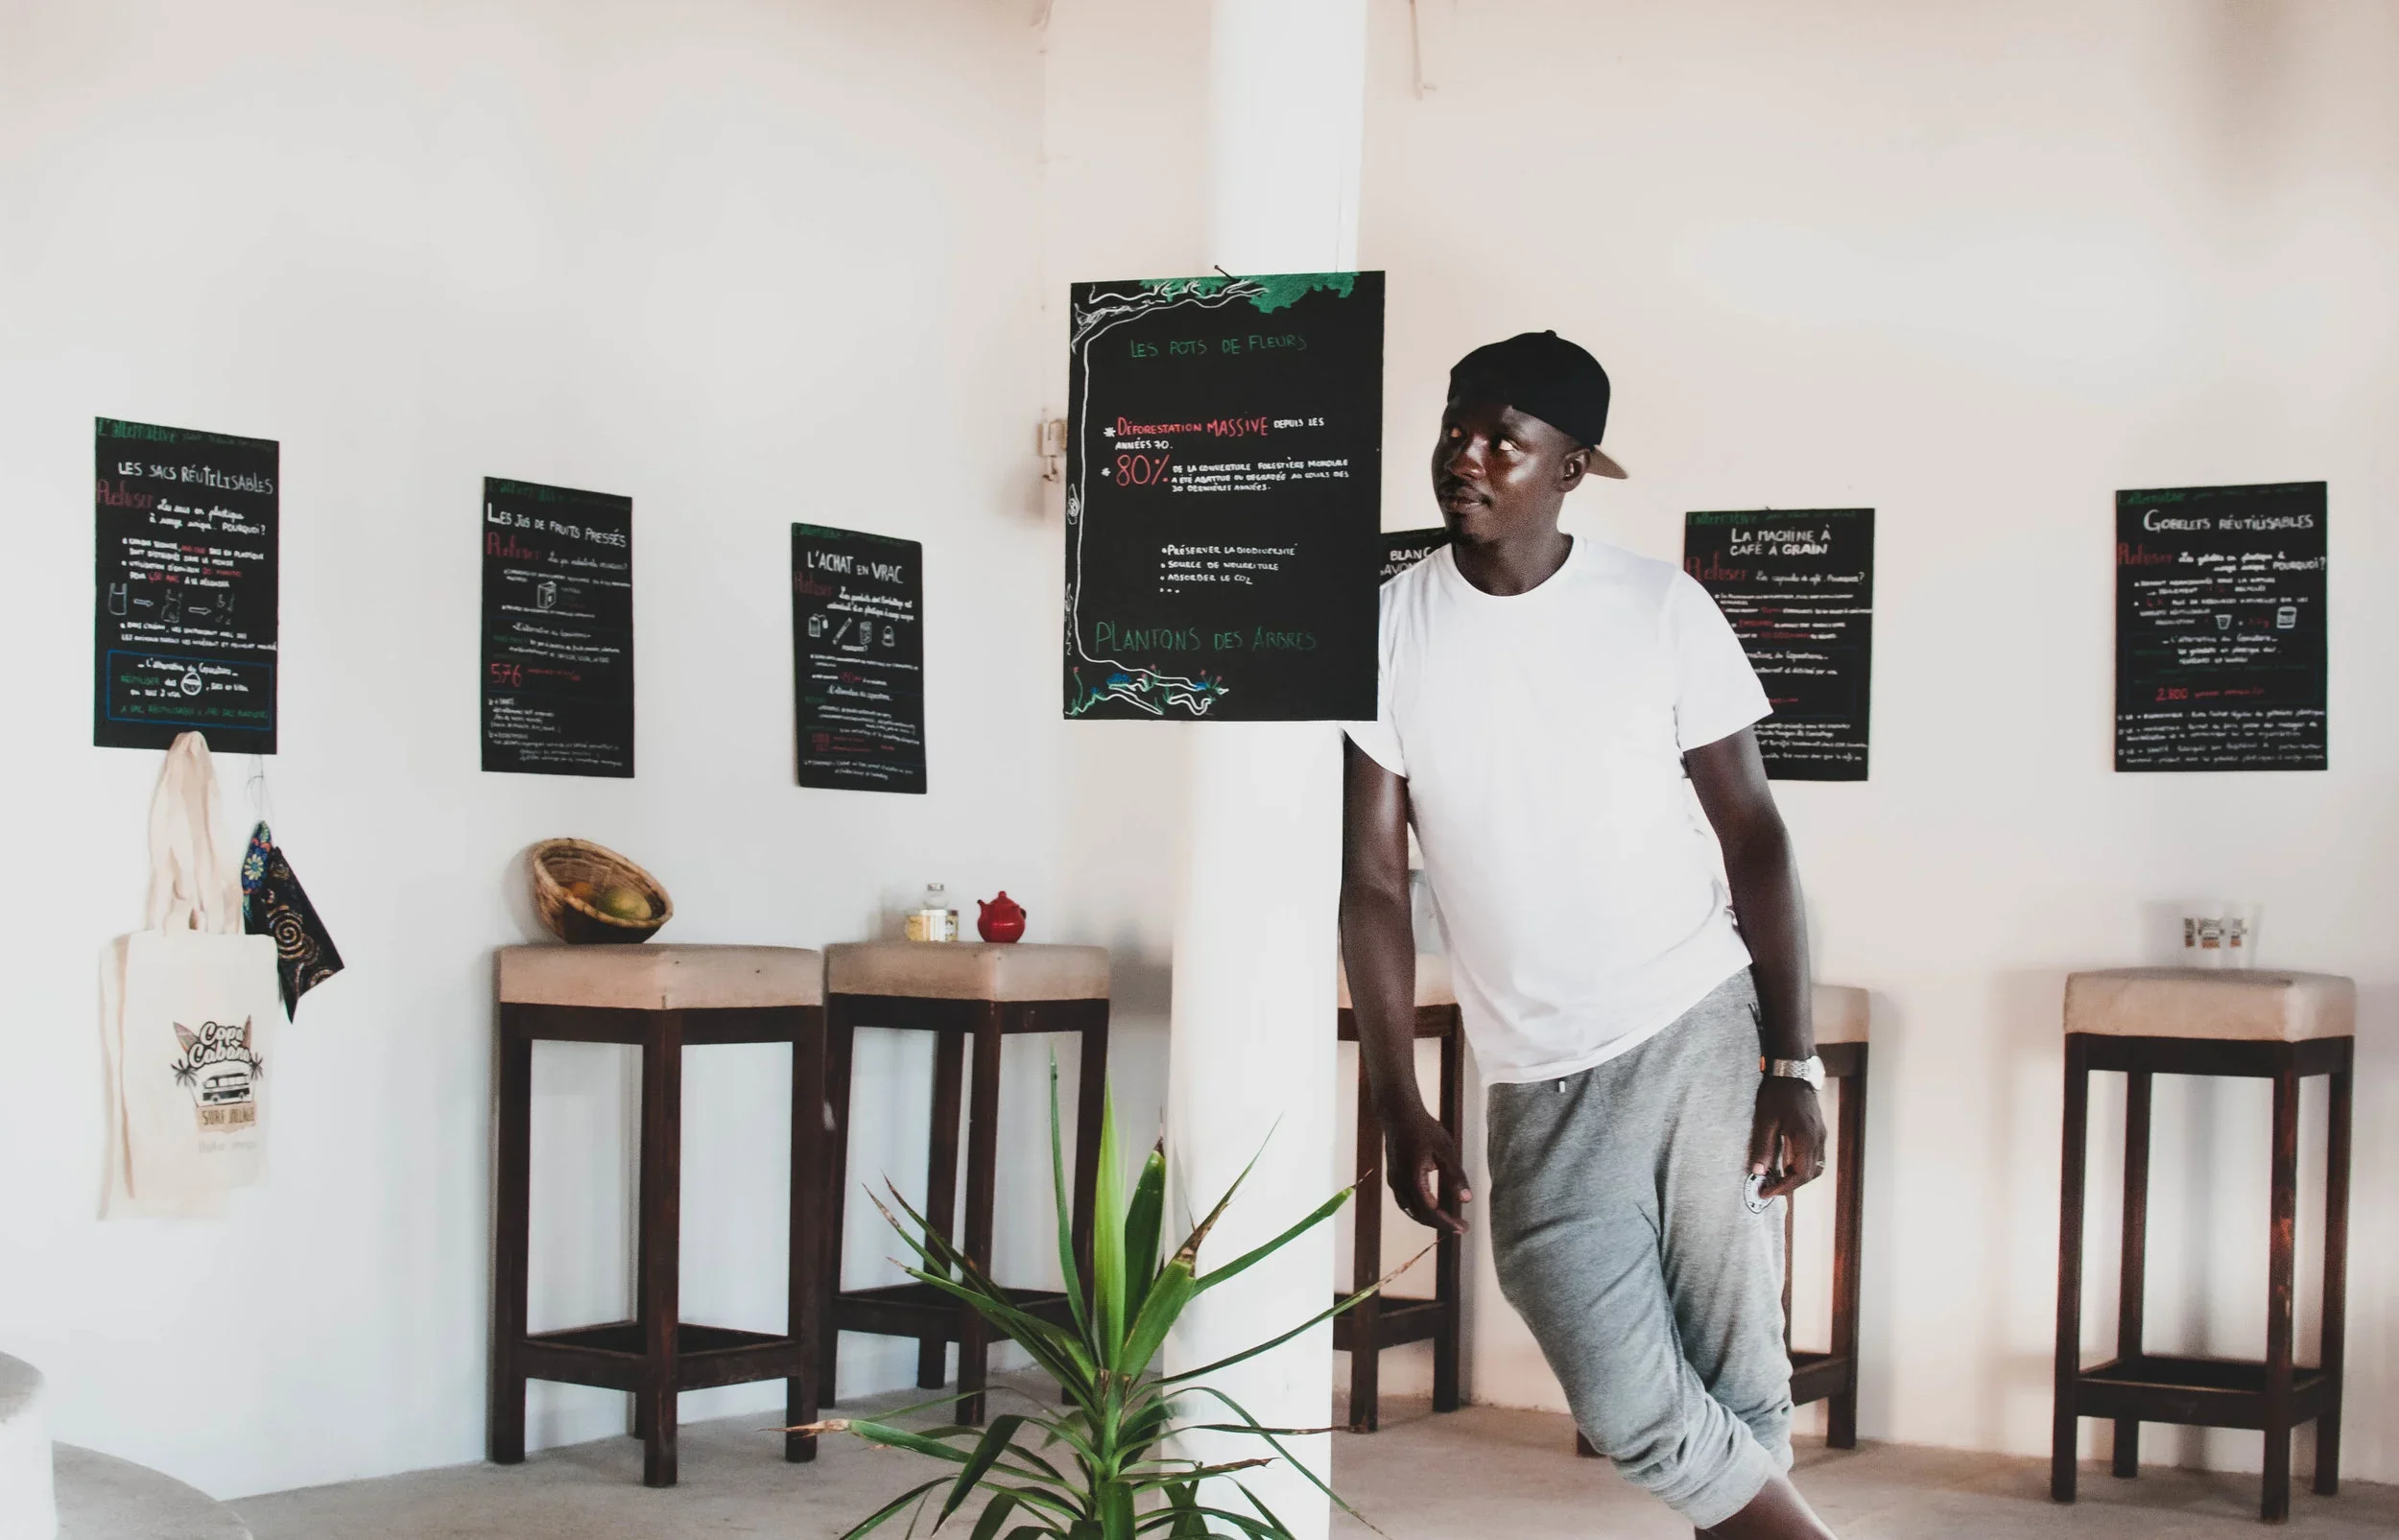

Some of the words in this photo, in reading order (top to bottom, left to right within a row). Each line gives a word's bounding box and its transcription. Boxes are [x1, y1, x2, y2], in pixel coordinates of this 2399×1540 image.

[1130, 340, 1159, 358] LES
[1169, 339, 1207, 356] POTS
[1222, 338, 1242, 355] DE
[1249, 335, 1308, 350] FLEURS
[1117, 416, 1202, 436] DÉFORESTATION
[1206, 416, 1269, 438] MASSIVE
[1273, 418, 1304, 429] DEPUIS
[1308, 416, 1324, 427] LES
[1115, 437, 1152, 450] ANNÉES
[118, 462, 143, 477] LES
[148, 464, 177, 481] SACS
[181, 464, 273, 494] RÉUTILISABLES
[1116, 454, 1170, 486] 80%
[1173, 464, 1183, 473] DE
[1187, 464, 1197, 473] LA
[1307, 459, 1348, 467] MONDIALE
[487, 503, 511, 526] LES
[514, 514, 530, 528] JUS
[534, 519, 545, 530] DE
[549, 521, 580, 538] FRUITS
[585, 529, 627, 547] PRESSÉS
[2143, 509, 2211, 533] GOBELETS
[2219, 514, 2314, 531] RÉUTILISABLES
[1731, 528, 1751, 542] LA
[1758, 527, 1814, 543] MACHINE
[1820, 524, 1832, 541] À
[1167, 544, 1222, 556] PRÉSERVER
[1224, 546, 1235, 555] LA
[1236, 543, 1297, 556] BIODIVERSITÉ
[1730, 541, 1763, 556] CAFÉ
[1782, 539, 1828, 556] GRAIN
[807, 550, 854, 574] L'ACHAT
[856, 565, 868, 576] EN
[871, 561, 904, 583] VRAC
[1168, 560, 1201, 569] SOURCE
[1223, 562, 1279, 571] NOURRITURE
[1094, 621, 1200, 653] PLANTONS
[1214, 630, 1244, 651] DES
[1251, 626, 1317, 652] ARBRES
